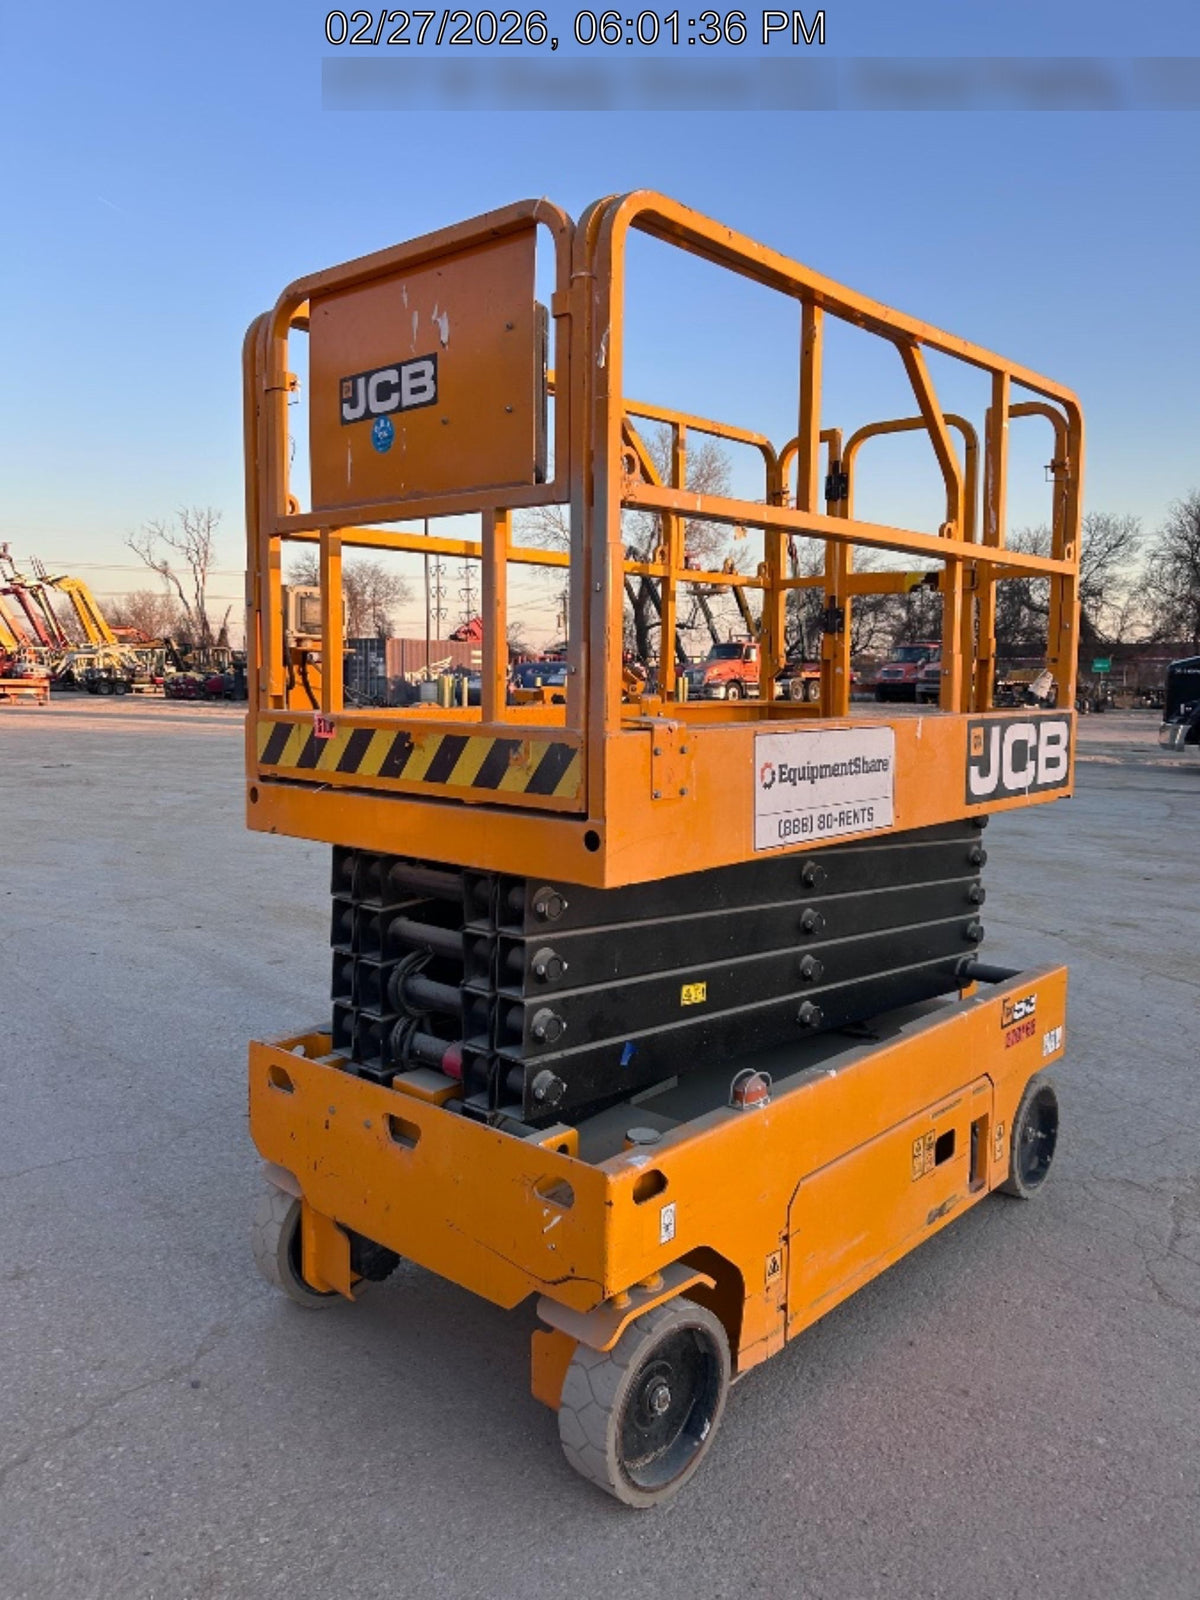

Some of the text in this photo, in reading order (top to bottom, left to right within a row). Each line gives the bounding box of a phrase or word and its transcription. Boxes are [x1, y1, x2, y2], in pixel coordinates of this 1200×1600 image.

[343, 360, 436, 420] JCB
[778, 756, 890, 787] EquipmentShare
[969, 721, 1069, 796] JCB
